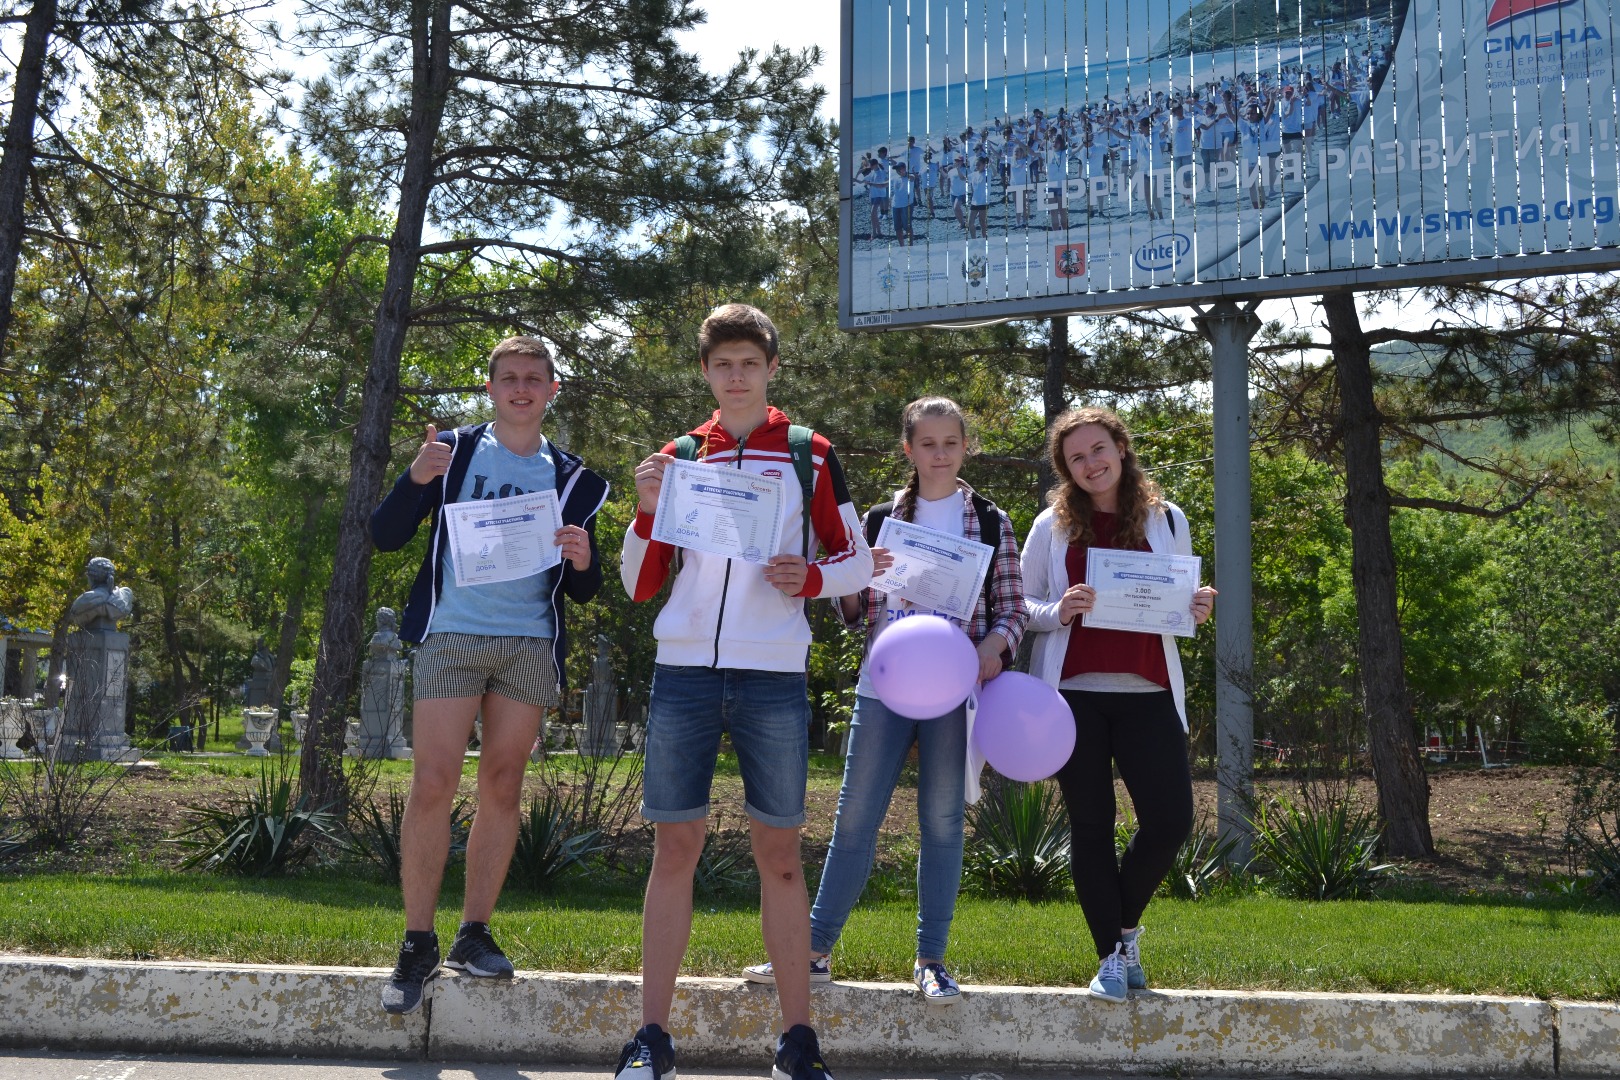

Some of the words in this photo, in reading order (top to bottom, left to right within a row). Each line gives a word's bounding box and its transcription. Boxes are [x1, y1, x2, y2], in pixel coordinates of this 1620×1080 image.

[1483, 25, 1602, 54] СМЕНА
[1484, 47, 1603, 69] ФЕДЕРАЛЬНЫЙ
[1576, 69, 1606, 80] ЦЕНТР
[1007, 152, 1302, 214] ТЕРРИТОРИЯ
[1319, 121, 1581, 181] РАЗВИТИЯ
[1319, 196, 1615, 242] www.smena.org
[1142, 240, 1181, 261] intel
